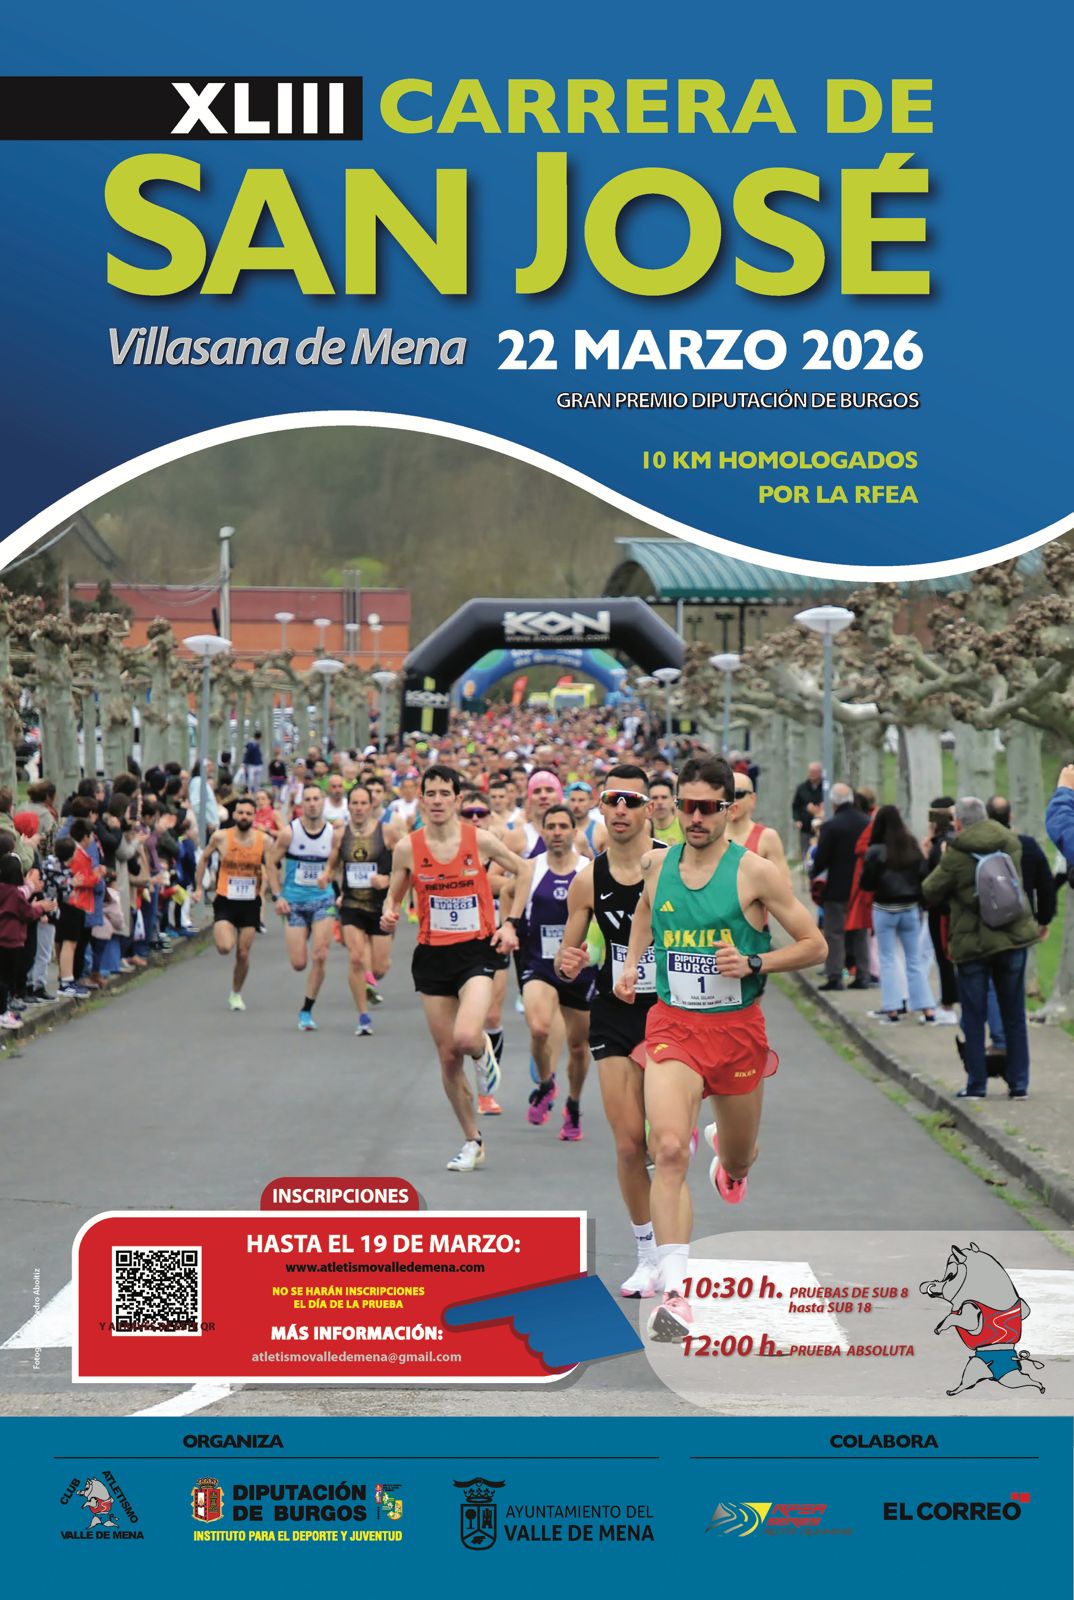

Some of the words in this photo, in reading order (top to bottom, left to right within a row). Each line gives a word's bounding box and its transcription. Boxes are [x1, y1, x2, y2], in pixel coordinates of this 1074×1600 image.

[171, 83, 343, 133] XLIII
[380, 79, 795, 133] CARRERA
[828, 80, 932, 132] DE
[105, 154, 466, 295] SAN
[516, 152, 929, 296] JOSÉ
[110, 327, 289, 365] Villasana
[296, 327, 345, 364] de
[351, 328, 466, 365] Mena
[498, 330, 557, 369] 22
[575, 330, 786, 370] MARZO
[803, 330, 923, 370] 2026
[556, 392, 611, 408] GRAN
[615, 392, 688, 408] PREMIO
[692, 389, 807, 408] DIPUTACIÓN
[811, 392, 837, 408] DE
[840, 392, 919, 408] BURGOS
[643, 451, 667, 469] 10
[673, 451, 711, 469] KM
[719, 450, 918, 469] HOMOLOGADOS
[759, 485, 810, 504] POR
[816, 485, 849, 504] LA
[855, 485, 919, 504] RFEA
[503, 611, 612, 635] KON
[425, 880, 474, 891] REINOSA
[434, 901, 474, 910] BURGOS
[449, 911, 459, 922] 9
[674, 954, 717, 965] DIPUTACI
[674, 962, 720, 974] BURGO
[636, 965, 646, 980] 3
[698, 976, 706, 994] 1
[273, 1188, 409, 1204] INSCRIPCIONES
[247, 1234, 323, 1254] HASTA
[328, 1234, 355, 1253] EL
[360, 1234, 388, 1253] 19
[393, 1234, 424, 1253] DE
[429, 1234, 521, 1253] MARZO:
[285, 1261, 485, 1273] www.atletismovalledemena.com
[33, 1268, 41, 1295] Aboitiz
[272, 1286, 289, 1296] NO
[290, 1286, 303, 1296] SE
[305, 1285, 343, 1296] HARÁN
[345, 1286, 425, 1296] INSCRIPCIONES
[683, 1278, 752, 1298] 10:30
[760, 1276, 782, 1298] h.
[789, 1287, 849, 1299] PRUEBAS
[851, 1287, 870, 1299] DE
[871, 1287, 898, 1298] SUB
[900, 1287, 909, 1298] 8
[293, 1299, 306, 1309] EL
[308, 1298, 328, 1309] DÍA
[329, 1299, 344, 1309] DE
[345, 1299, 360, 1309] LA
[361, 1299, 404, 1309] PRUEBA
[788, 1301, 825, 1313] hasta
[827, 1301, 854, 1313] SUB
[857, 1302, 872, 1313] 18
[271, 1323, 310, 1341] MÁS
[313, 1323, 443, 1341] INFORMACIÓN:
[683, 1336, 752, 1356] 12:00
[759, 1334, 782, 1356] h.
[789, 1345, 841, 1357] PRUEBA
[846, 1345, 915, 1357] ABSOLUTA
[251, 1351, 462, 1365] atletismovalledemena@gmail.com
[182, 1434, 284, 1449] ORGANIZA
[829, 1434, 939, 1449] COLABORA
[60, 1478, 81, 1505] CLUB
[102, 1470, 139, 1523] ATLETISMO
[232, 1480, 367, 1501] DIPUTACIÓN
[232, 1505, 264, 1522] DE
[274, 1504, 368, 1522] BURGOS
[505, 1505, 621, 1519] AYUNTAMIENTO
[626, 1505, 654, 1519] DEL
[883, 1502, 914, 1521] EL
[916, 1501, 1022, 1521] CORREO
[60, 1530, 94, 1540] VALLE
[95, 1531, 110, 1540] DE
[112, 1531, 145, 1540] MENA
[193, 1530, 246, 1541] INSTITUTO
[249, 1530, 275, 1541] PARA
[277, 1531, 289, 1541] EL
[292, 1530, 337, 1541] DEPORTE
[341, 1531, 347, 1540] Y
[350, 1530, 403, 1541] JUVENTUD
[503, 1524, 563, 1542] VALLE
[568, 1524, 593, 1542] DE
[599, 1524, 655, 1542] MENA
